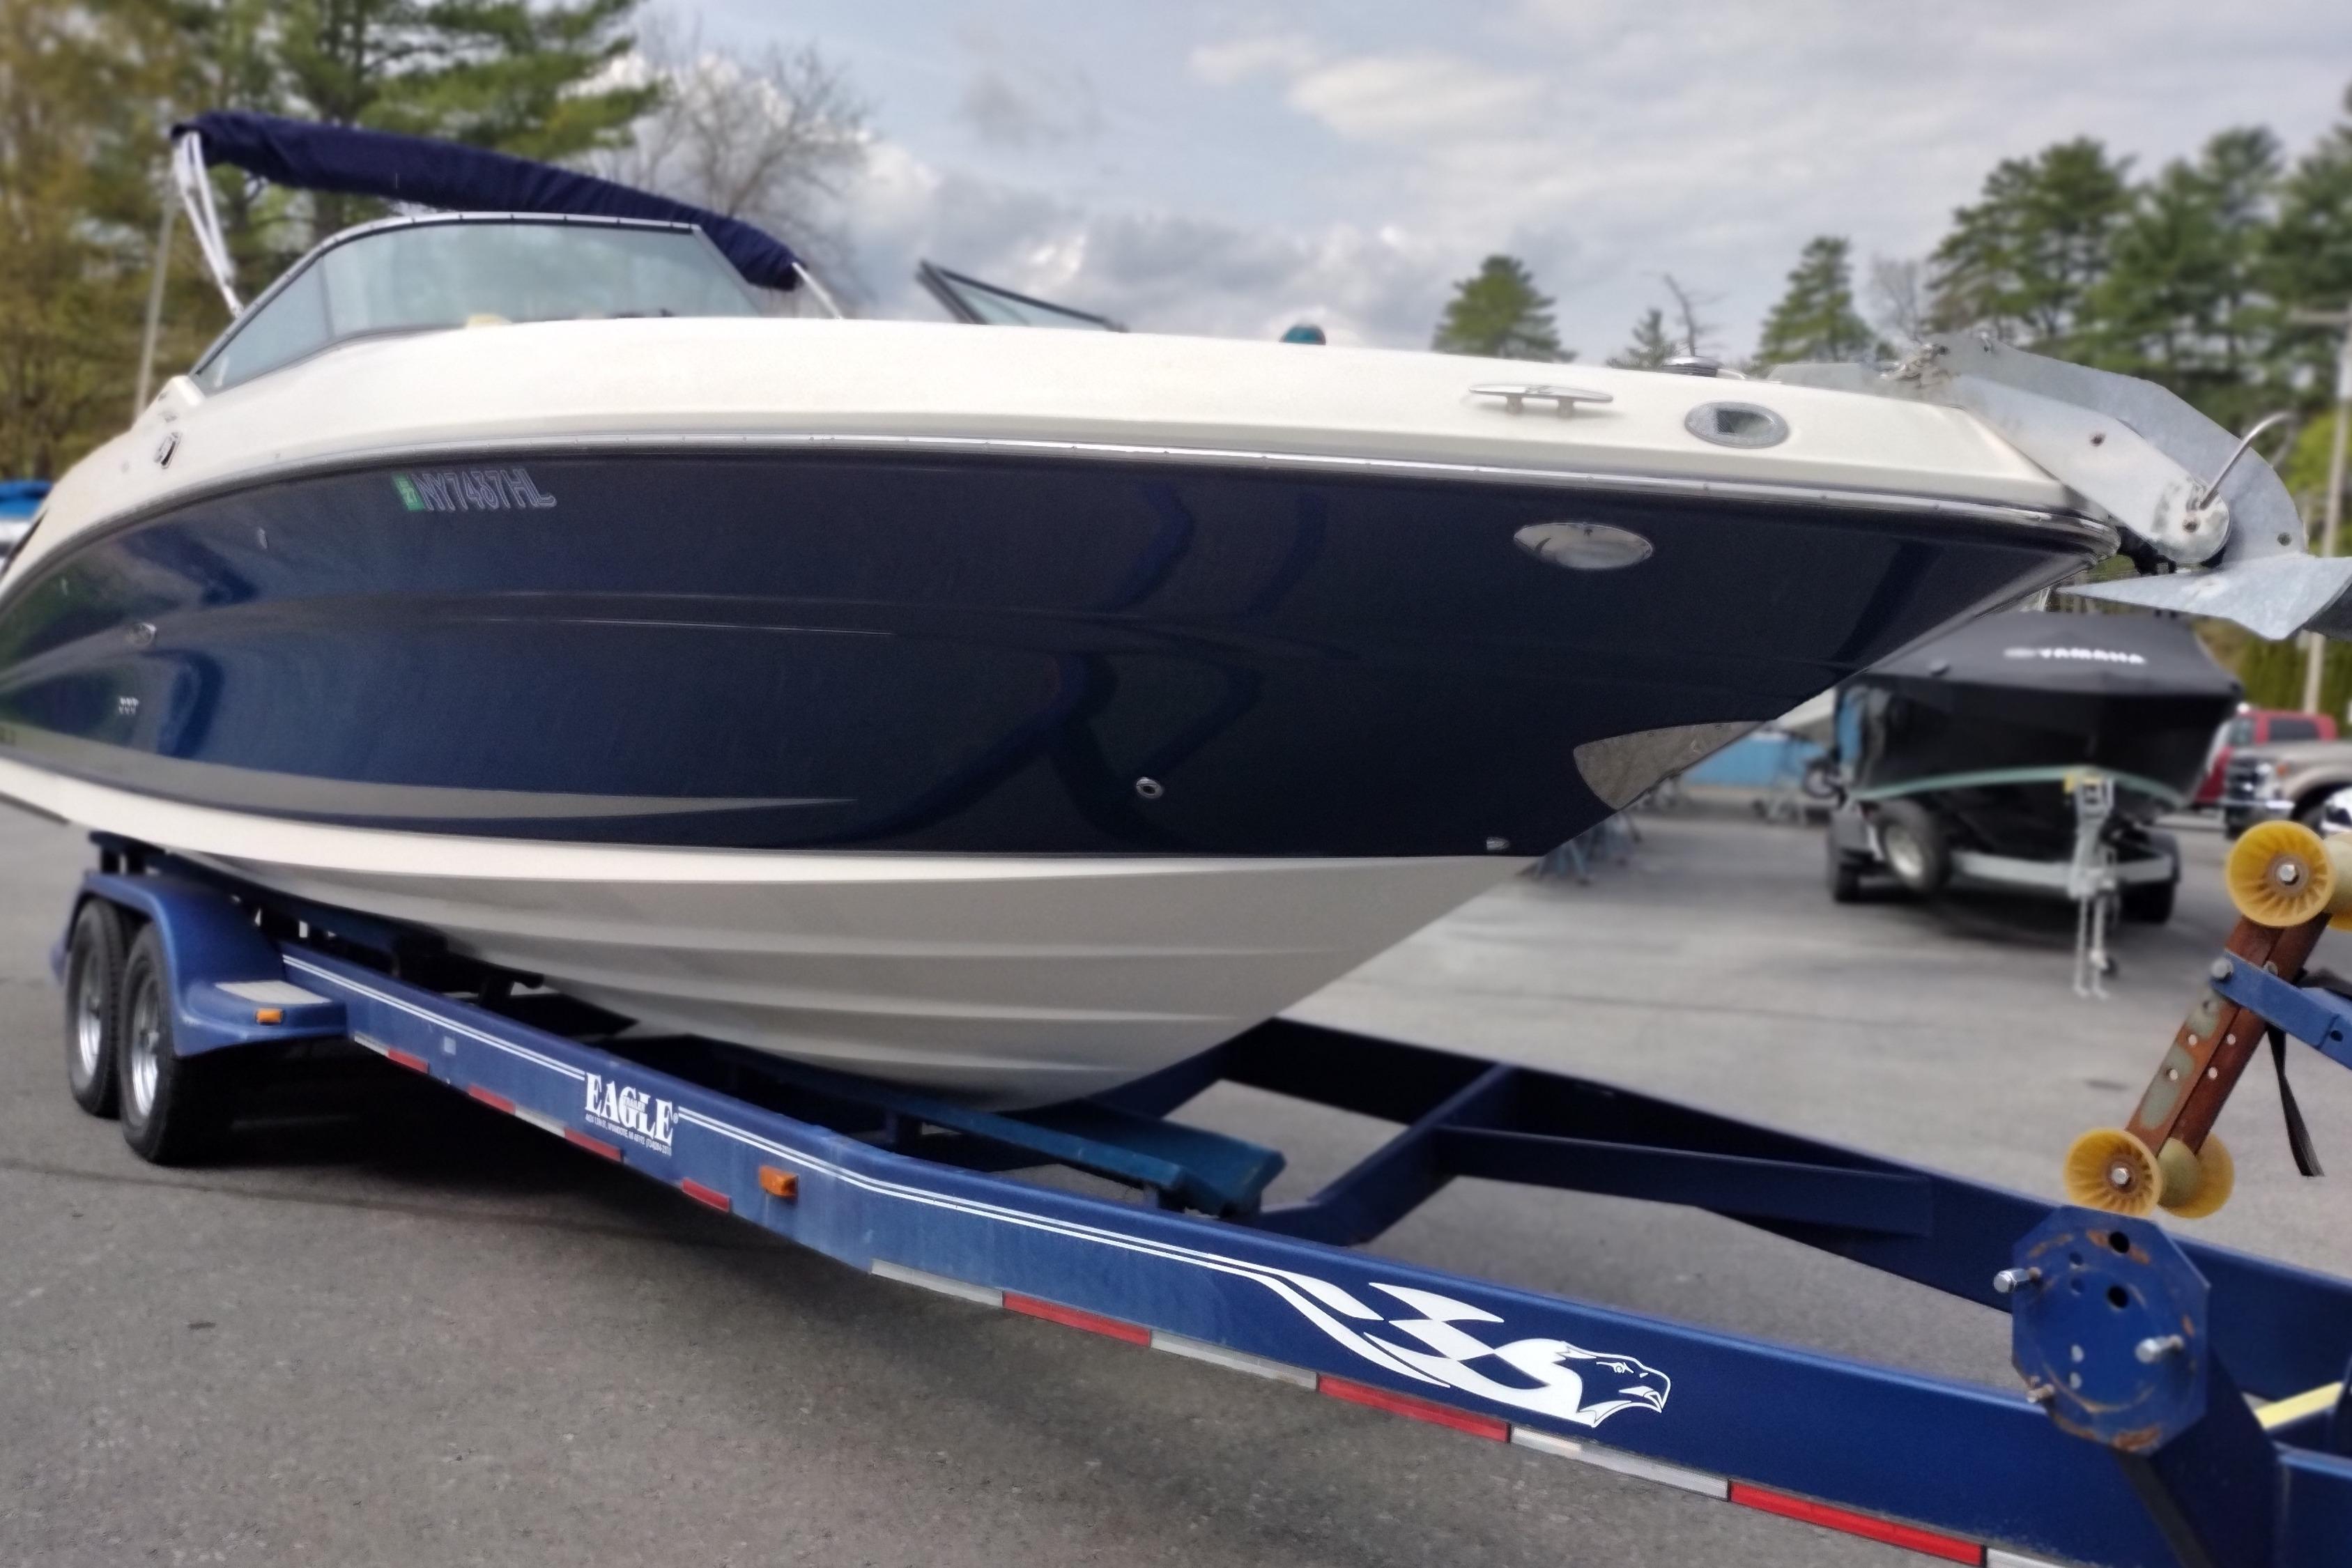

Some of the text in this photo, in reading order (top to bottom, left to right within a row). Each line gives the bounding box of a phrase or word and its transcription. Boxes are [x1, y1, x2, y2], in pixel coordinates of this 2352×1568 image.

[2039, 647, 2146, 664] YAMAHA
[585, 1073, 673, 1146] EAGLE
[622, 1096, 645, 1113] TRAILER
